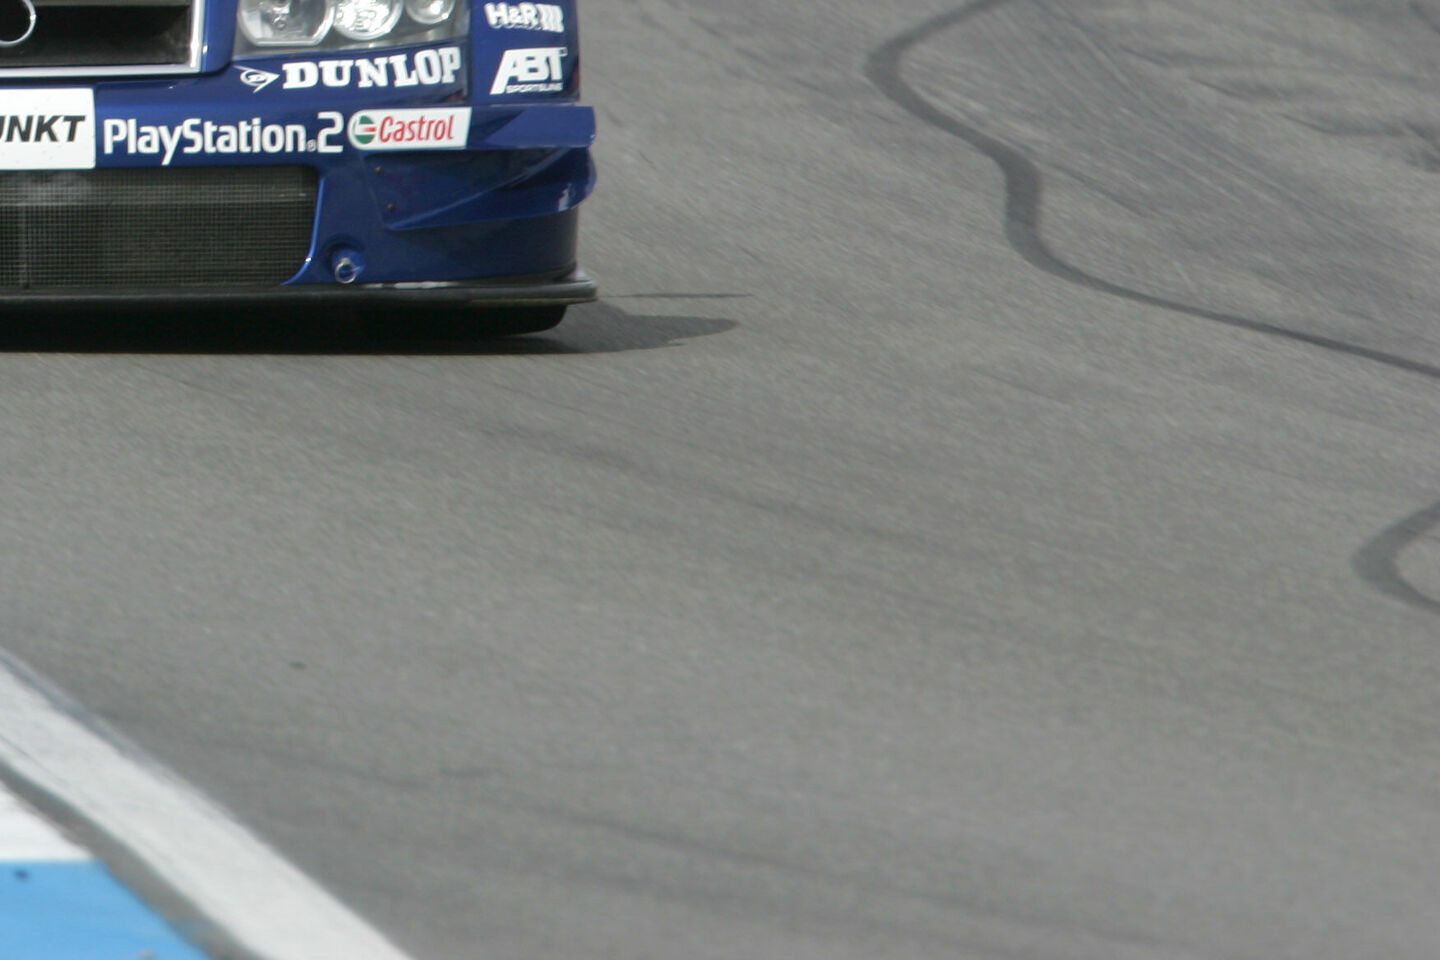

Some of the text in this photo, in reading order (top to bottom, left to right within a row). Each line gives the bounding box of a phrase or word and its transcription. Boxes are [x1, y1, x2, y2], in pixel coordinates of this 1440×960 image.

[282, 46, 461, 90] DUNLOP
[490, 47, 564, 95] ABT
[379, 113, 455, 144] Castrol
